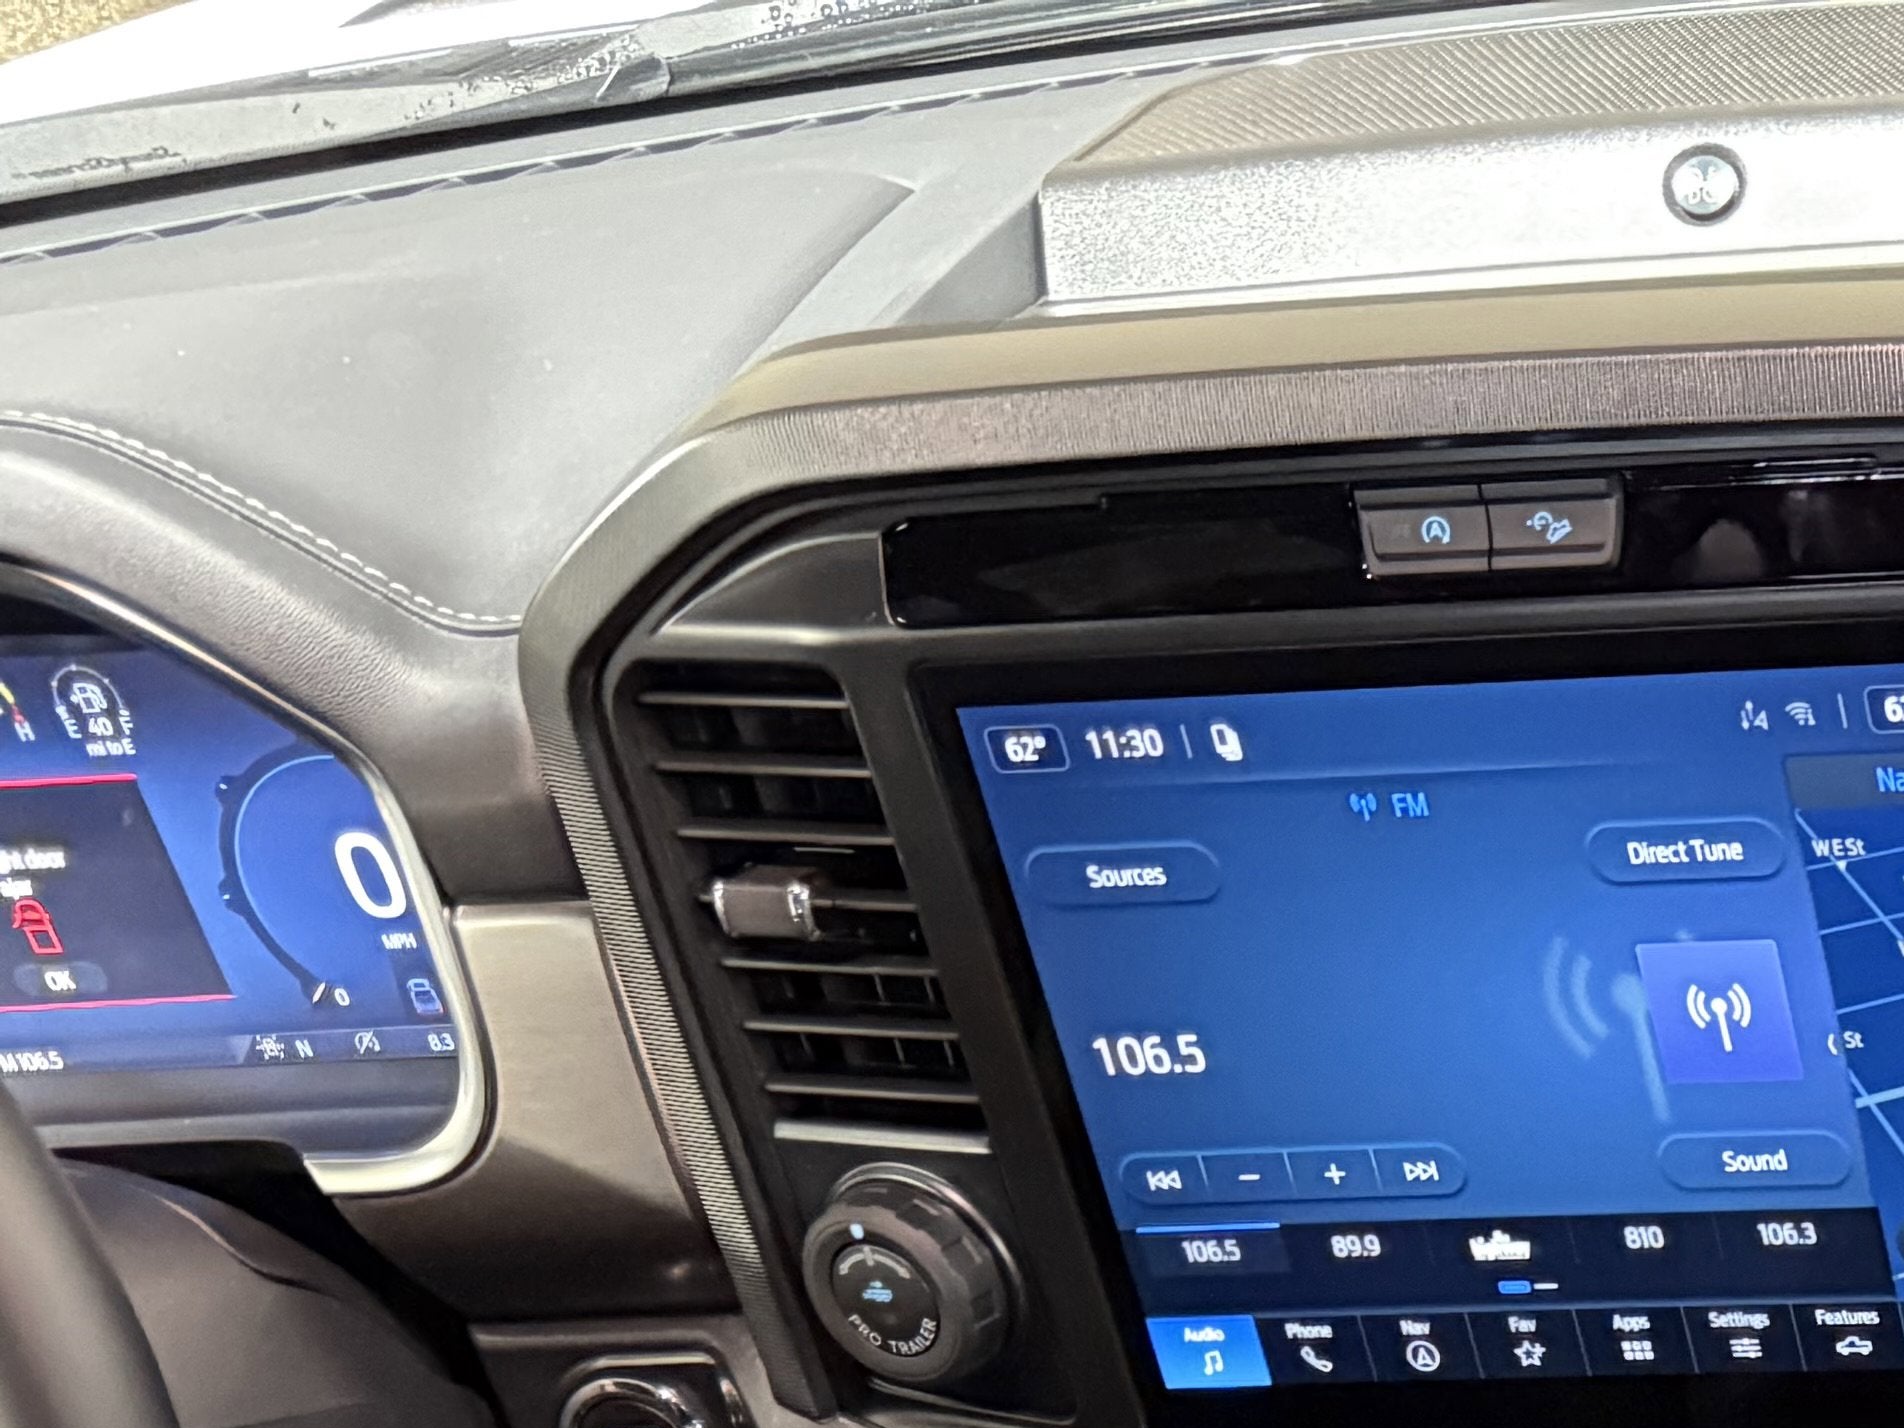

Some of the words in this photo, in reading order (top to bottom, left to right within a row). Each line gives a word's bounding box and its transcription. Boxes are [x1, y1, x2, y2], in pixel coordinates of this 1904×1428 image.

[88, 716, 114, 736] 40
[1084, 728, 1164, 760] 11:30
[1391, 792, 1430, 818] FM
[1626, 838, 1687, 866] Direct
[1688, 837, 1744, 863] Tune
[1811, 838, 1829, 857] W
[1831, 838, 1845, 856] E
[1845, 837, 1867, 856] St
[333, 831, 408, 919] 0
[1086, 865, 1167, 889] Sources
[381, 932, 418, 950] MPH
[44, 970, 77, 991] OK
[295, 1040, 314, 1058] N
[1092, 1034, 1208, 1076] 106.5
[1722, 1149, 1788, 1174] Sound
[1623, 1225, 1665, 1250] 810
[1756, 1222, 1818, 1247] 106.3
[1182, 1240, 1241, 1263] 106.5
[1331, 1235, 1381, 1258] 89.9
[1400, 1319, 1431, 1337] Nav
[1508, 1314, 1537, 1334] Fav
[1612, 1313, 1651, 1333] Apps
[1708, 1310, 1770, 1331] Settings
[1815, 1308, 1881, 1327] Features
[848, 1313, 883, 1347] PRO
[886, 1317, 937, 1355] TRAILER
[1183, 1326, 1225, 1343] Audio
[1285, 1320, 1333, 1340] Phone
